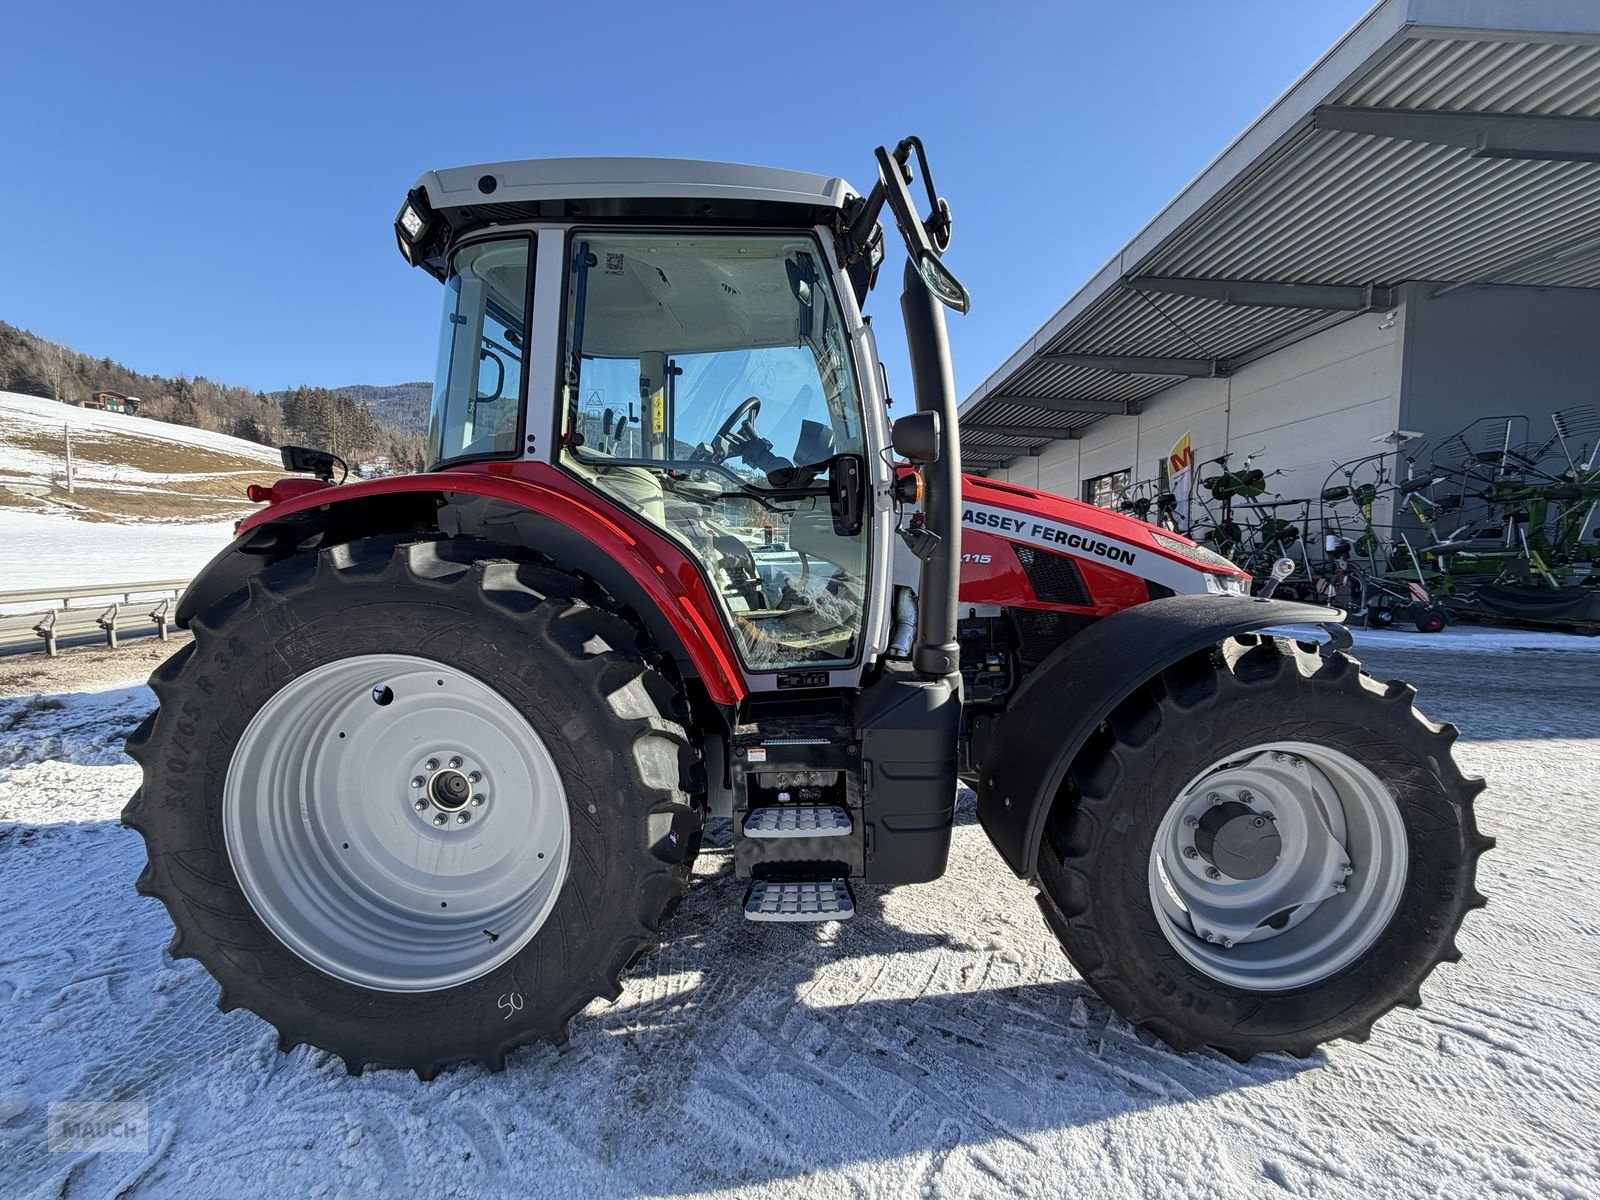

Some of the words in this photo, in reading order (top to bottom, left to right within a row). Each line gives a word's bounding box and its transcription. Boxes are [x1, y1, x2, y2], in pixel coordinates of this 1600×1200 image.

[1170, 446, 1190, 472] M
[961, 509, 1027, 533] ASSEY
[1030, 523, 1136, 566] FERGUSON
